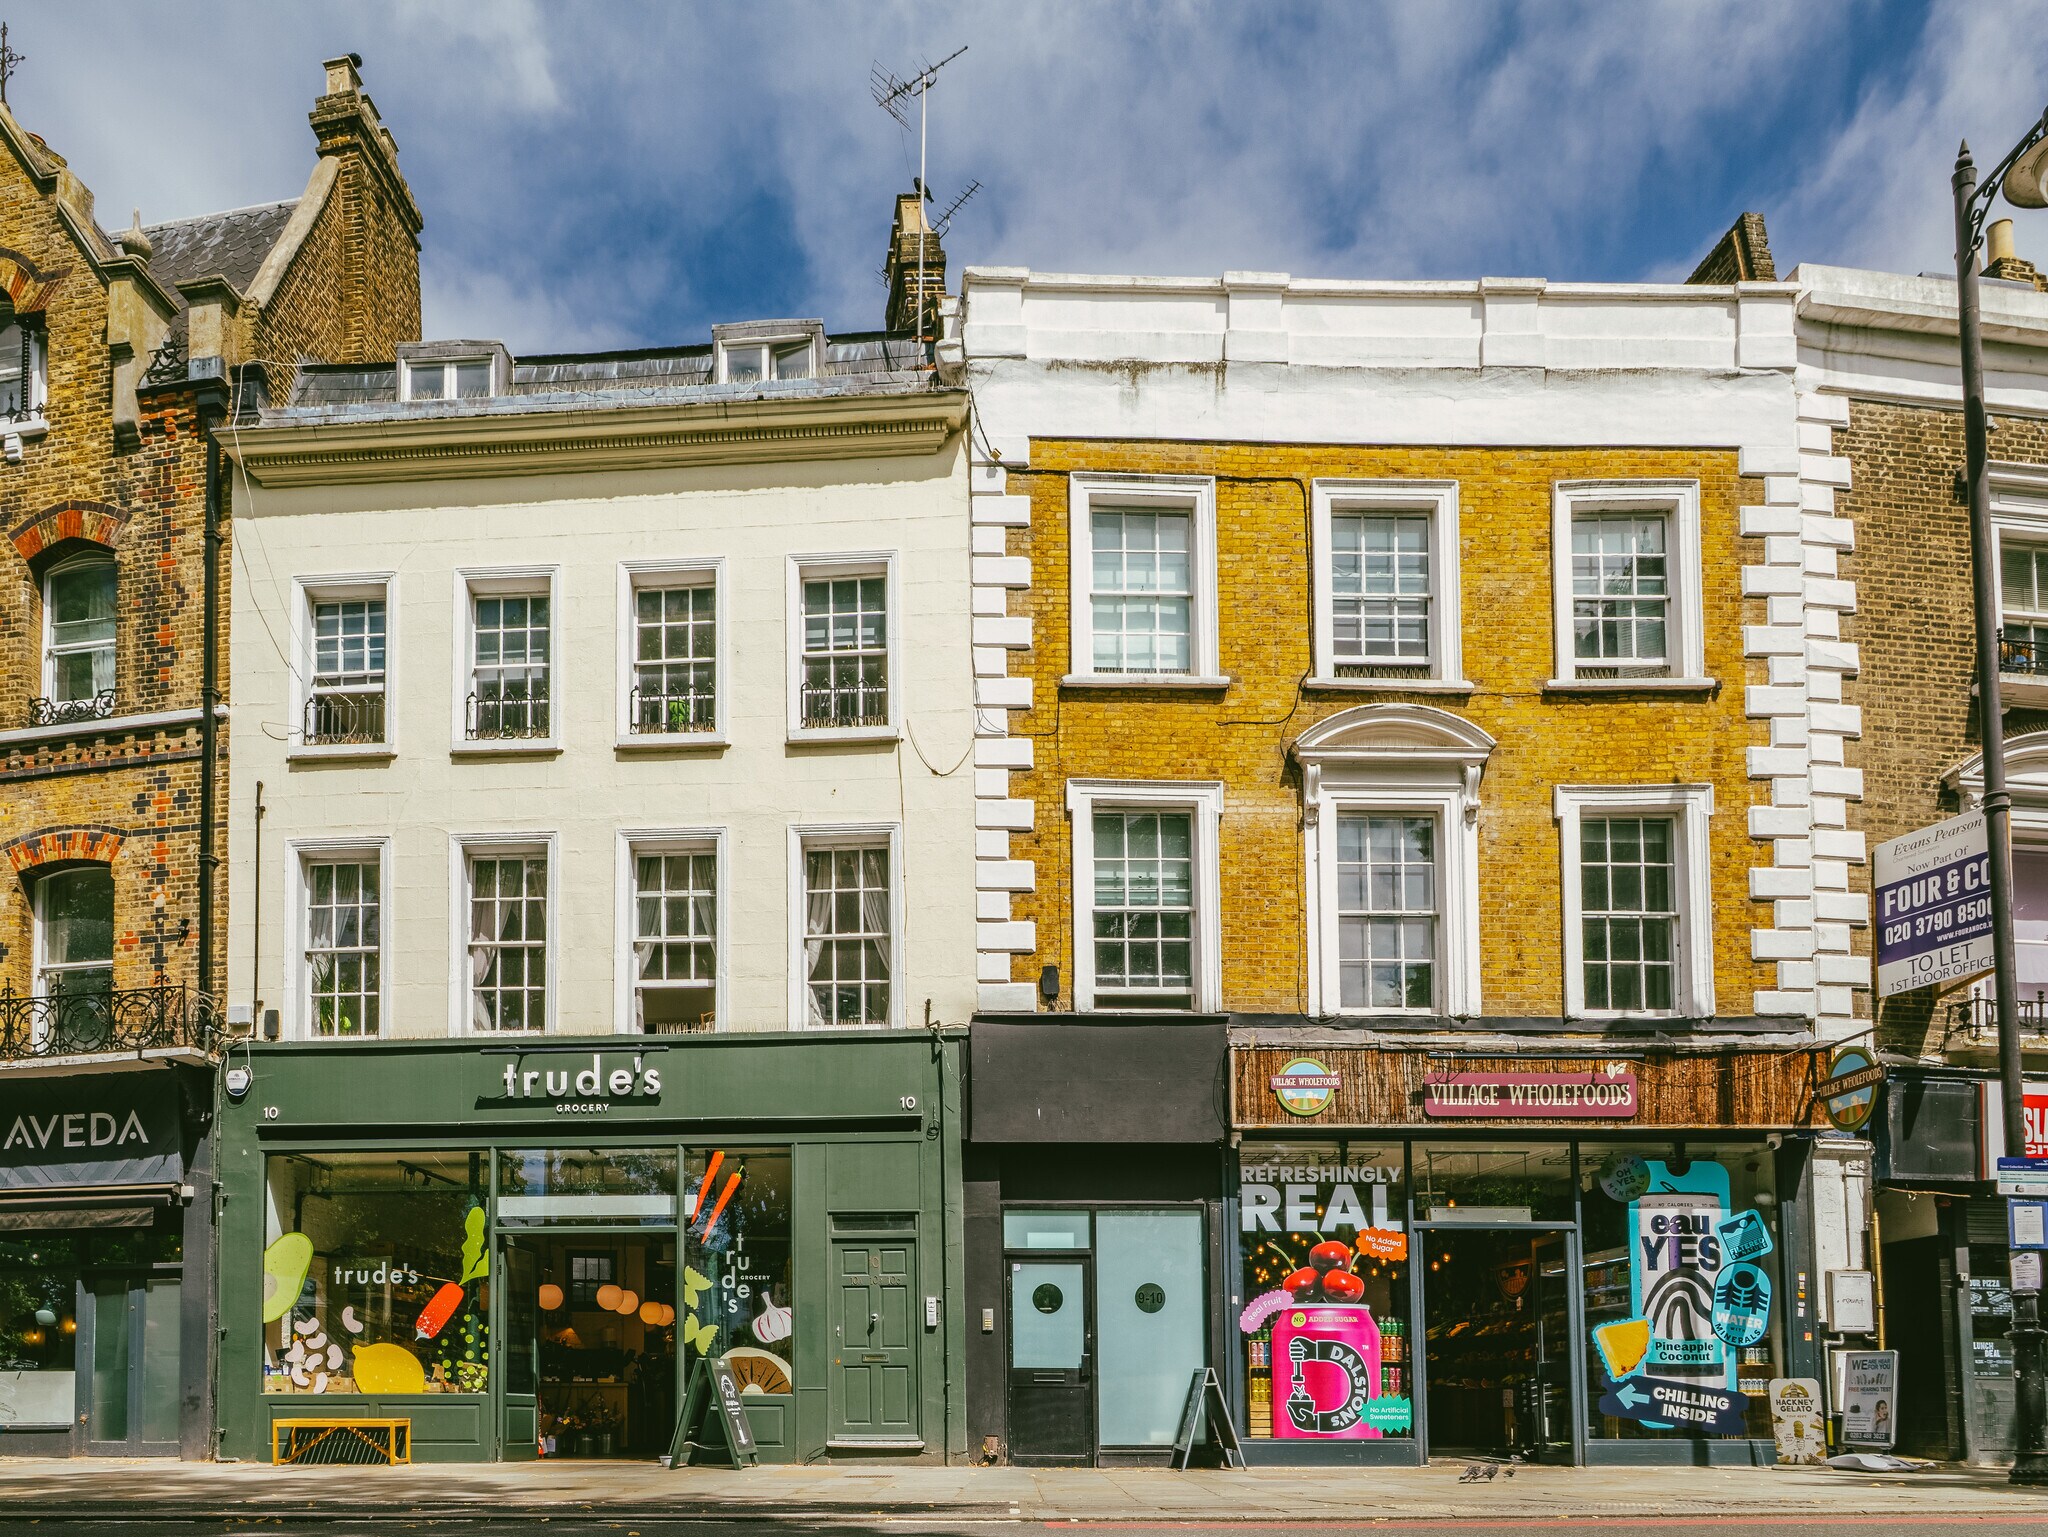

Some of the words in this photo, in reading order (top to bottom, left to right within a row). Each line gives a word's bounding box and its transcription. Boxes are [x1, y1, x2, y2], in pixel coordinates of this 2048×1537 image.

[1893, 836, 1931, 856] Evans
[1934, 818, 1983, 842] Pearson
[1907, 860, 1930, 875] Now
[1933, 853, 1952, 866] Part
[1954, 845, 1969, 858] Of
[1884, 875, 1943, 918] FOUR
[1947, 868, 1961, 895] &
[1885, 921, 1911, 946] 020
[1915, 908, 1953, 936] 3790
[1936, 920, 1993, 942] WWW.FOURANDCO.U
[1907, 954, 1933, 975] TO
[1940, 942, 1973, 967] LET
[1890, 978, 1908, 993] 1ST
[1911, 967, 1950, 987] FLOOR
[503, 1054, 661, 1096] trude's
[1272, 1077, 1296, 1086] VILLAGE
[1298, 1077, 1340, 1086] WHOLEFOODS
[1820, 1080, 1841, 1097] VILLAGE
[1842, 1066, 1883, 1090] WHOLEFOODS
[900, 1096, 916, 1109] 10
[1430, 1083, 1500, 1106] VILLAGE
[1508, 1083, 1632, 1106] WHOLEFOODS
[263, 1106, 279, 1119] 10
[556, 1103, 610, 1113] GROCERY
[3, 1109, 149, 1150] AVEDA
[1241, 1166, 1402, 1183] REFRESHINGLY
[1616, 1168, 1632, 1178] OH
[1616, 1175, 1636, 1187] YES
[1607, 1174, 1645, 1197] MINERALS
[1241, 1184, 1403, 1233] REAL
[1650, 1214, 1710, 1235] eau
[1365, 1234, 1377, 1243] No
[1377, 1237, 1402, 1247] Added
[1371, 1242, 1394, 1253] Sugar
[1730, 1237, 1765, 1255] FILTERED
[1741, 1243, 1767, 1255] NATURE
[1641, 1235, 1721, 1272] YES
[334, 1262, 418, 1284] trude's
[1982, 1279, 2000, 1287] PIZZA
[1138, 1292, 1163, 1304] 9-10
[1247, 1306, 1264, 1322] Real
[1263, 1296, 1282, 1309] Fruit
[1716, 1311, 1763, 1329] WATER
[1715, 1323, 1761, 1344] MINERALS
[1655, 1341, 1713, 1353] Pineapple
[1660, 1351, 1711, 1361] Coconut
[1973, 1342, 1994, 1350] LUNCH
[1984, 1349, 2001, 1357] DEAL
[1851, 1359, 1868, 1371] WE
[1330, 1345, 1366, 1427] DALSTON'S
[1653, 1387, 1730, 1411] CHILLING
[1661, 1403, 1717, 1424] INSIDE
